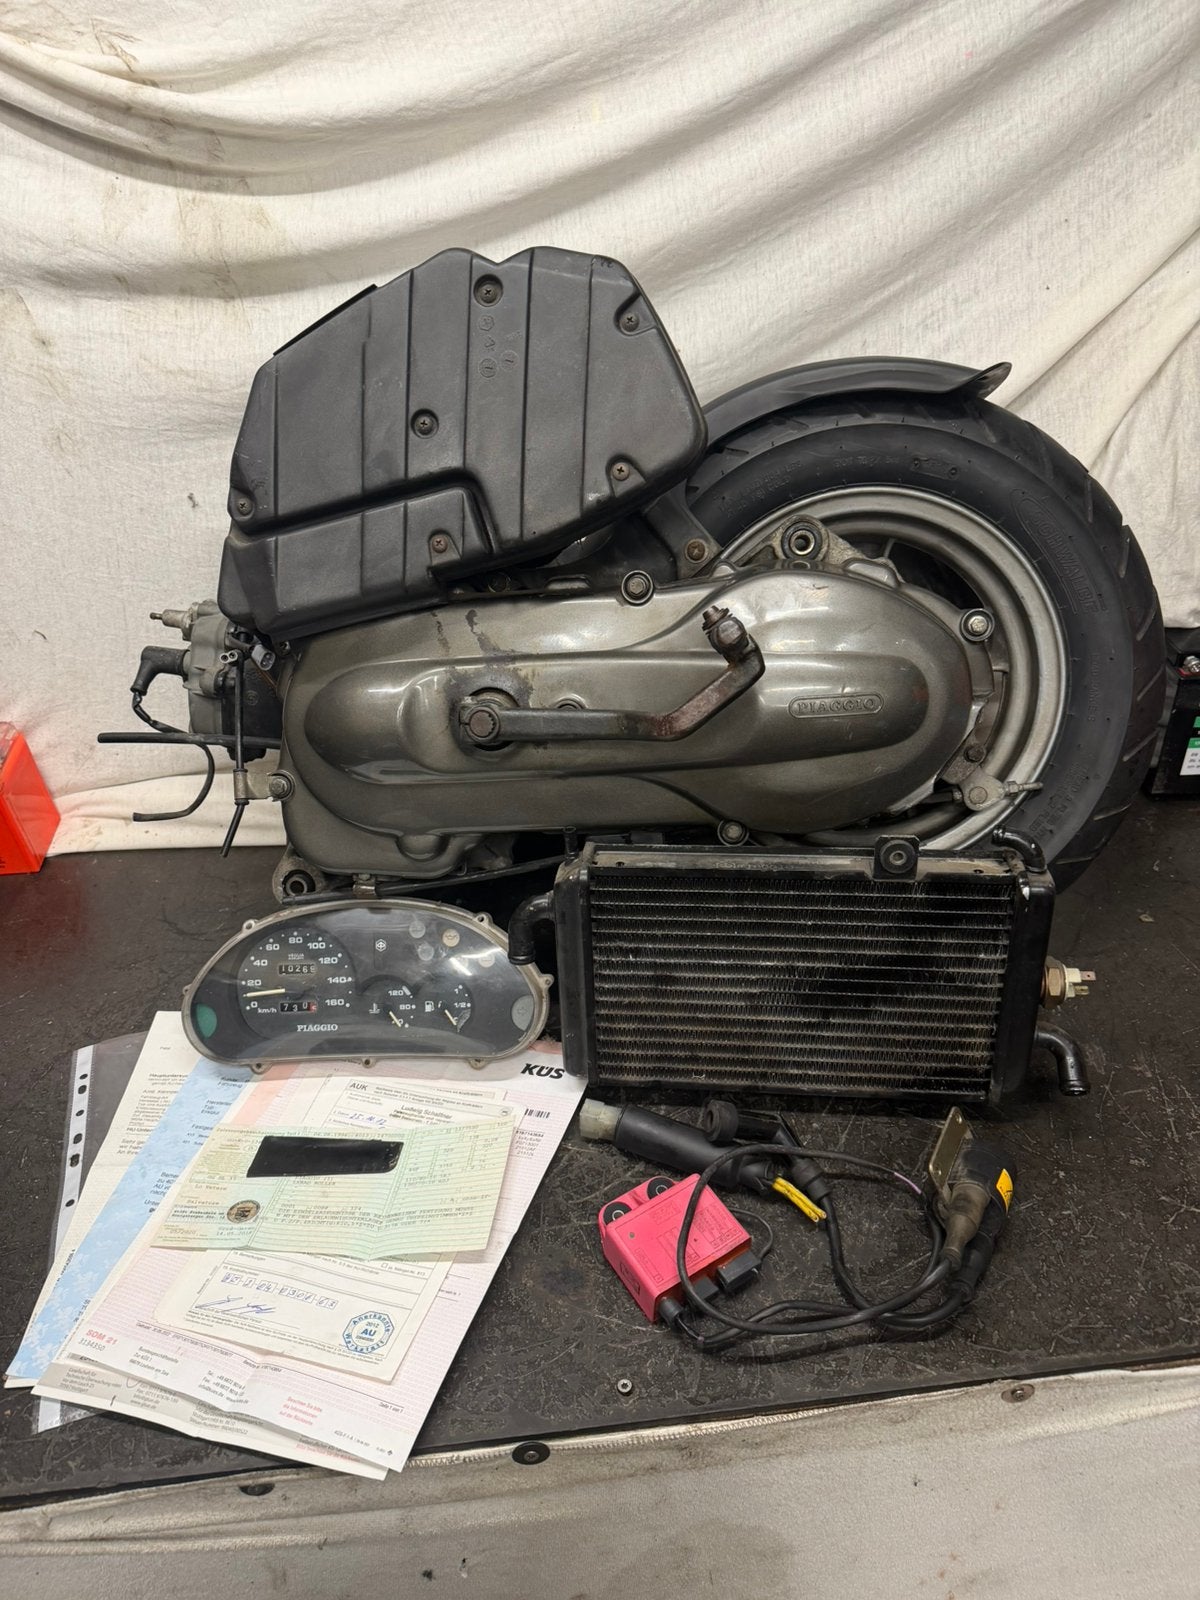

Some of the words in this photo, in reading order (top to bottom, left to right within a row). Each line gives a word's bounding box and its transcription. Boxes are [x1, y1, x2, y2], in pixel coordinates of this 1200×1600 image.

[798, 698, 874, 714] PIAGGIO
[288, 936, 303, 944] 80
[327, 976, 347, 984] 140
[325, 998, 345, 1006] 160
[297, 1023, 338, 1032] PIAGGIO
[520, 1063, 565, 1080] KÜS
[350, 1082, 368, 1092] AUK
[86, 1329, 106, 1341] SOM
[106, 1336, 118, 1345] 21
[361, 1328, 377, 1337] AU
